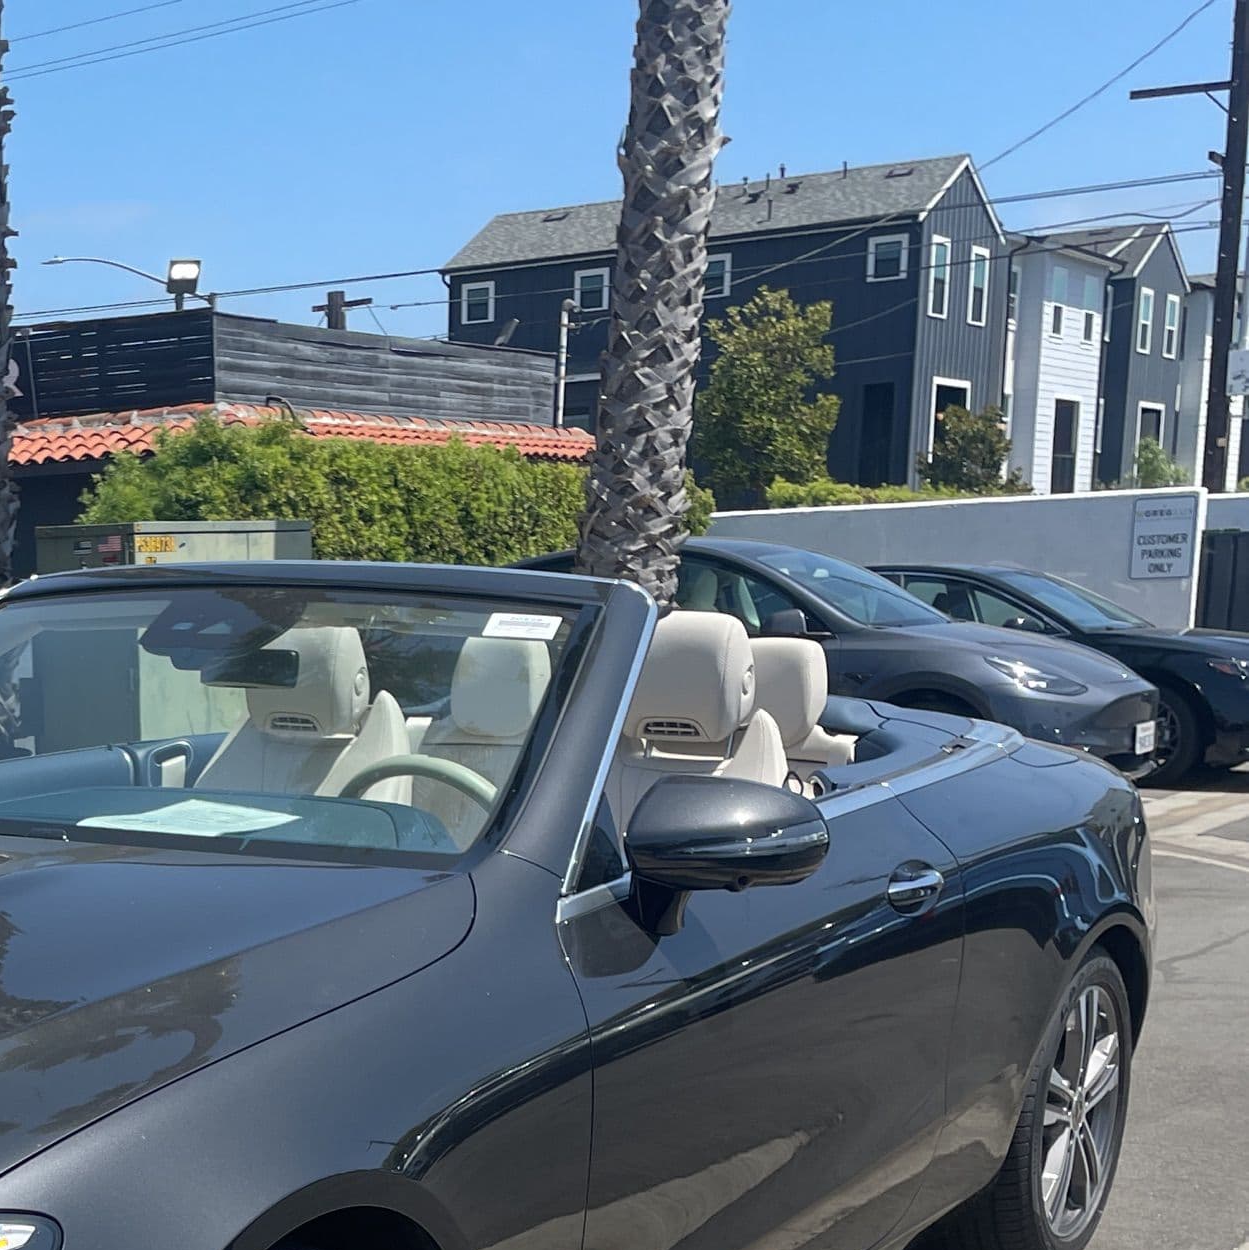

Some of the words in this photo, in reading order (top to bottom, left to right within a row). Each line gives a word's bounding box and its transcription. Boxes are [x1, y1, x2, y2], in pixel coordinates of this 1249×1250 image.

[1137, 533, 1189, 546] CUSTOMER
[1141, 548, 1182, 560] PARKING
[1148, 562, 1173, 573] ONLY
